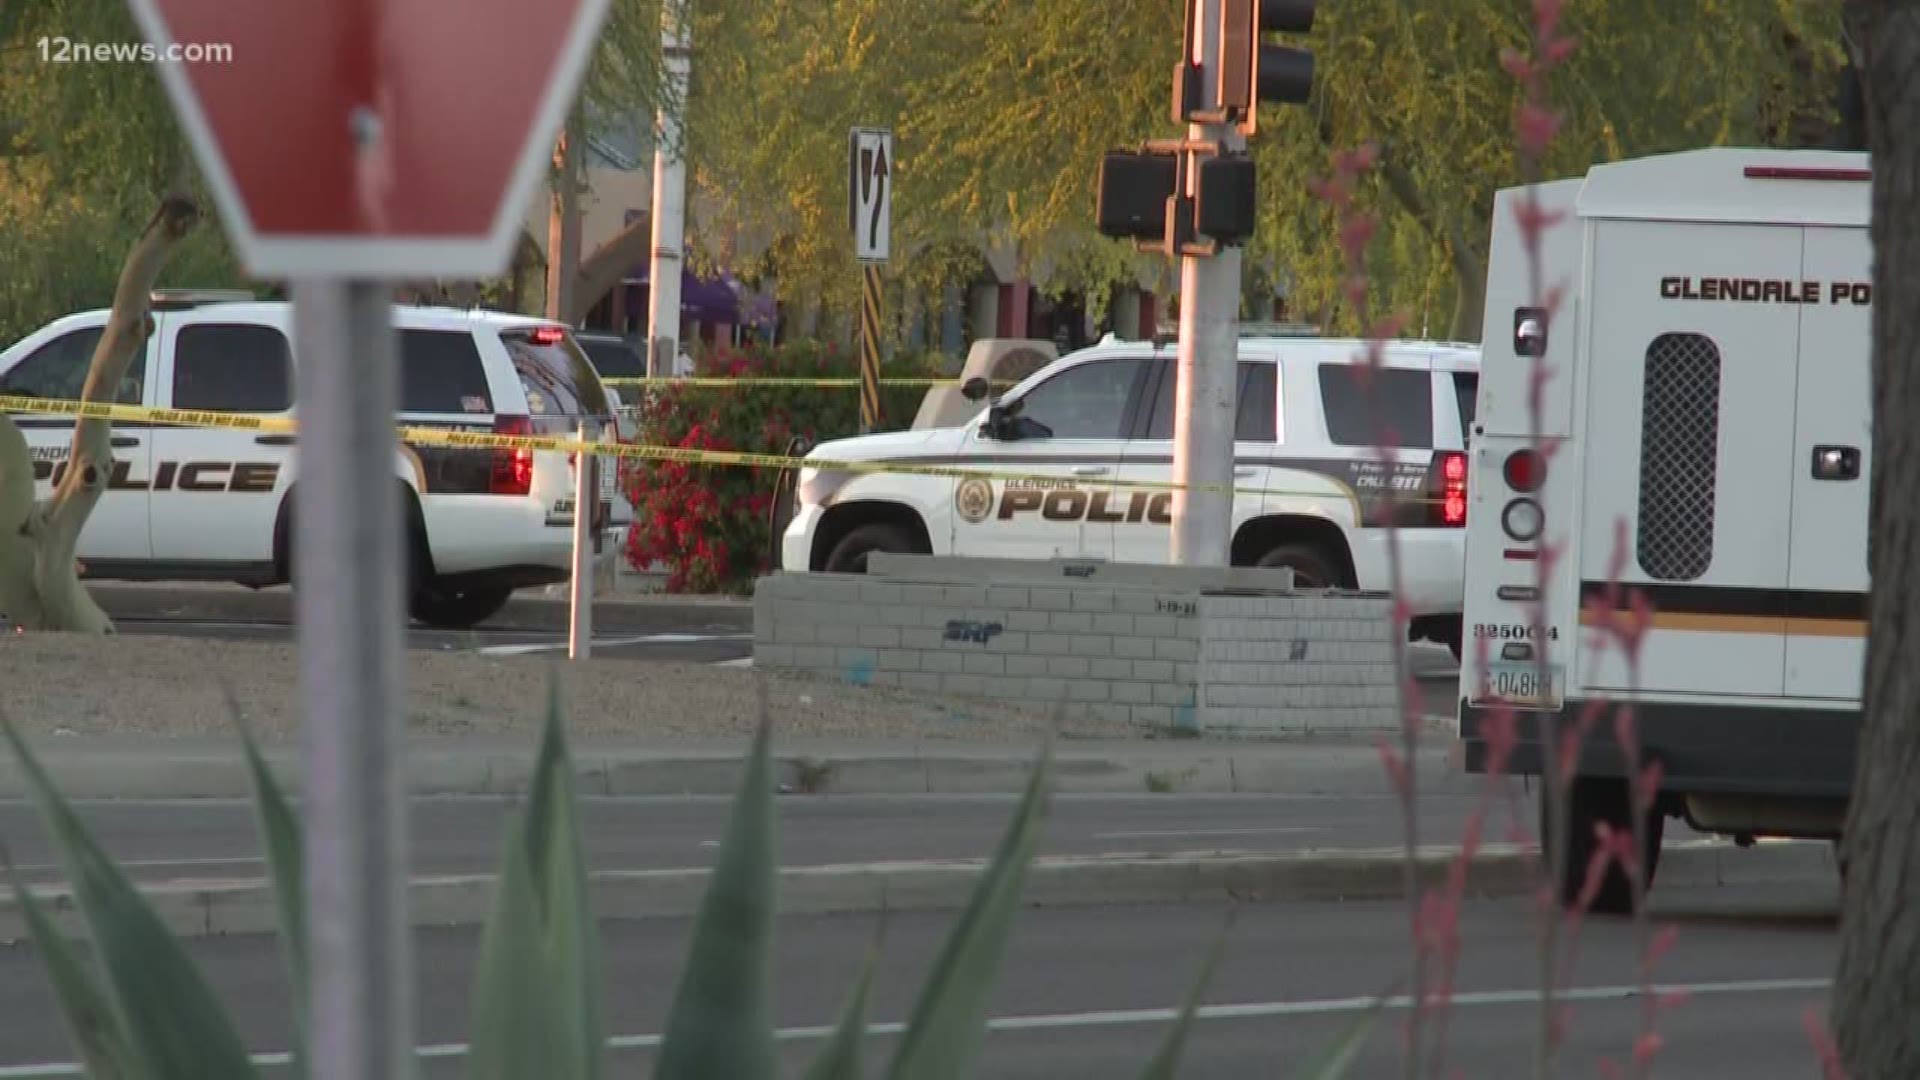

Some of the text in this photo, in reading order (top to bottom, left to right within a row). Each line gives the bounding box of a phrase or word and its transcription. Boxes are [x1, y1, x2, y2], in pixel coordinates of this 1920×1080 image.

[1660, 276, 1820, 303] GLENDALE
[1391, 474, 1422, 490] 911
[1484, 670, 1554, 698] -048HH
